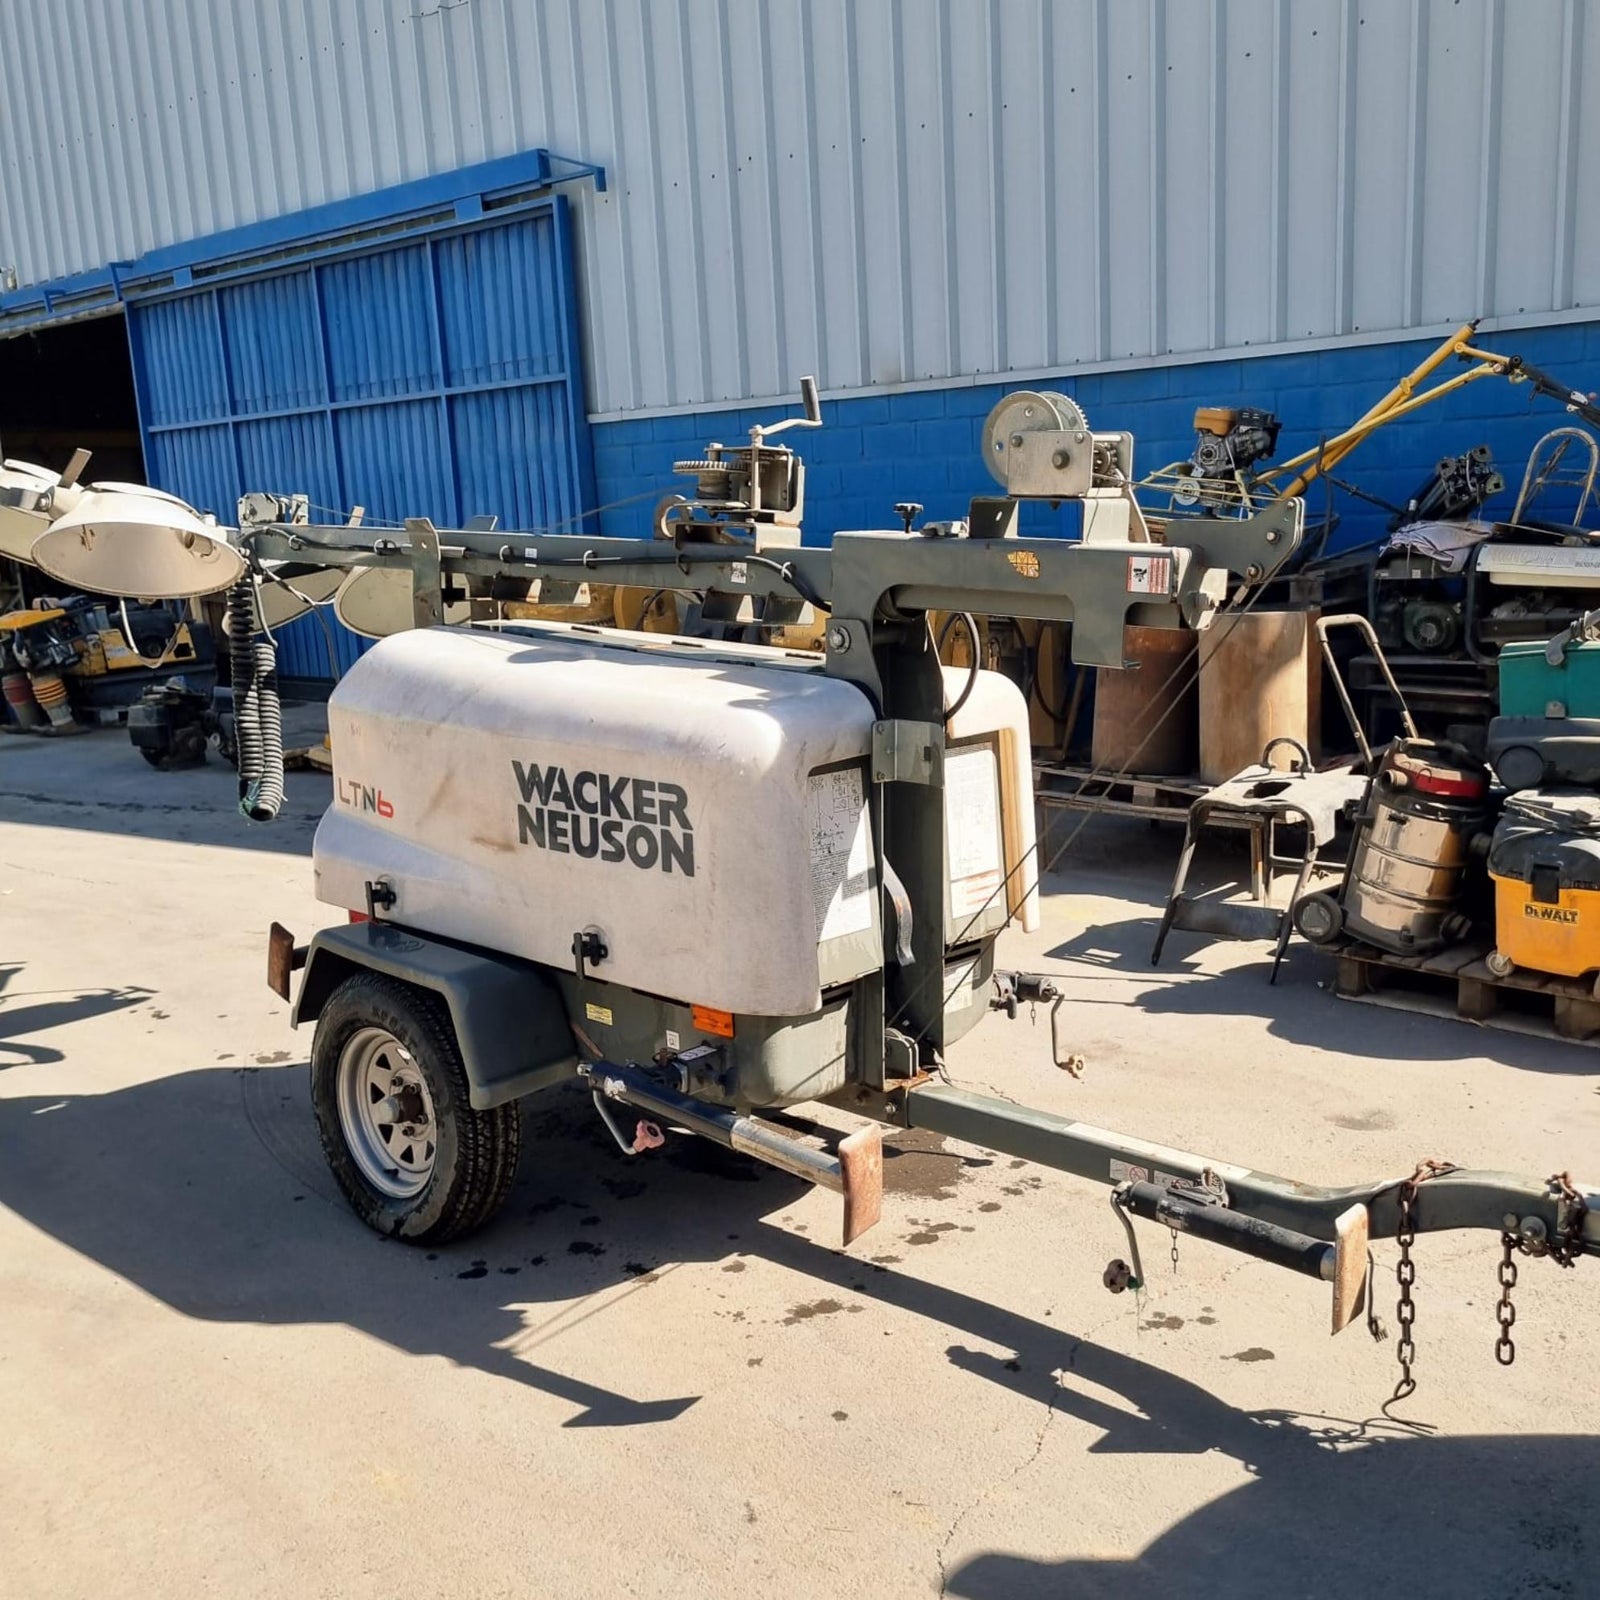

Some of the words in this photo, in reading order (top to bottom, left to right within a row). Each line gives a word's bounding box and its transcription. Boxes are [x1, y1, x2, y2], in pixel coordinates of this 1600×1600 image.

[338, 777, 394, 818] LTN6
[512, 760, 693, 830] WACKER
[518, 804, 695, 877] NEUSON
